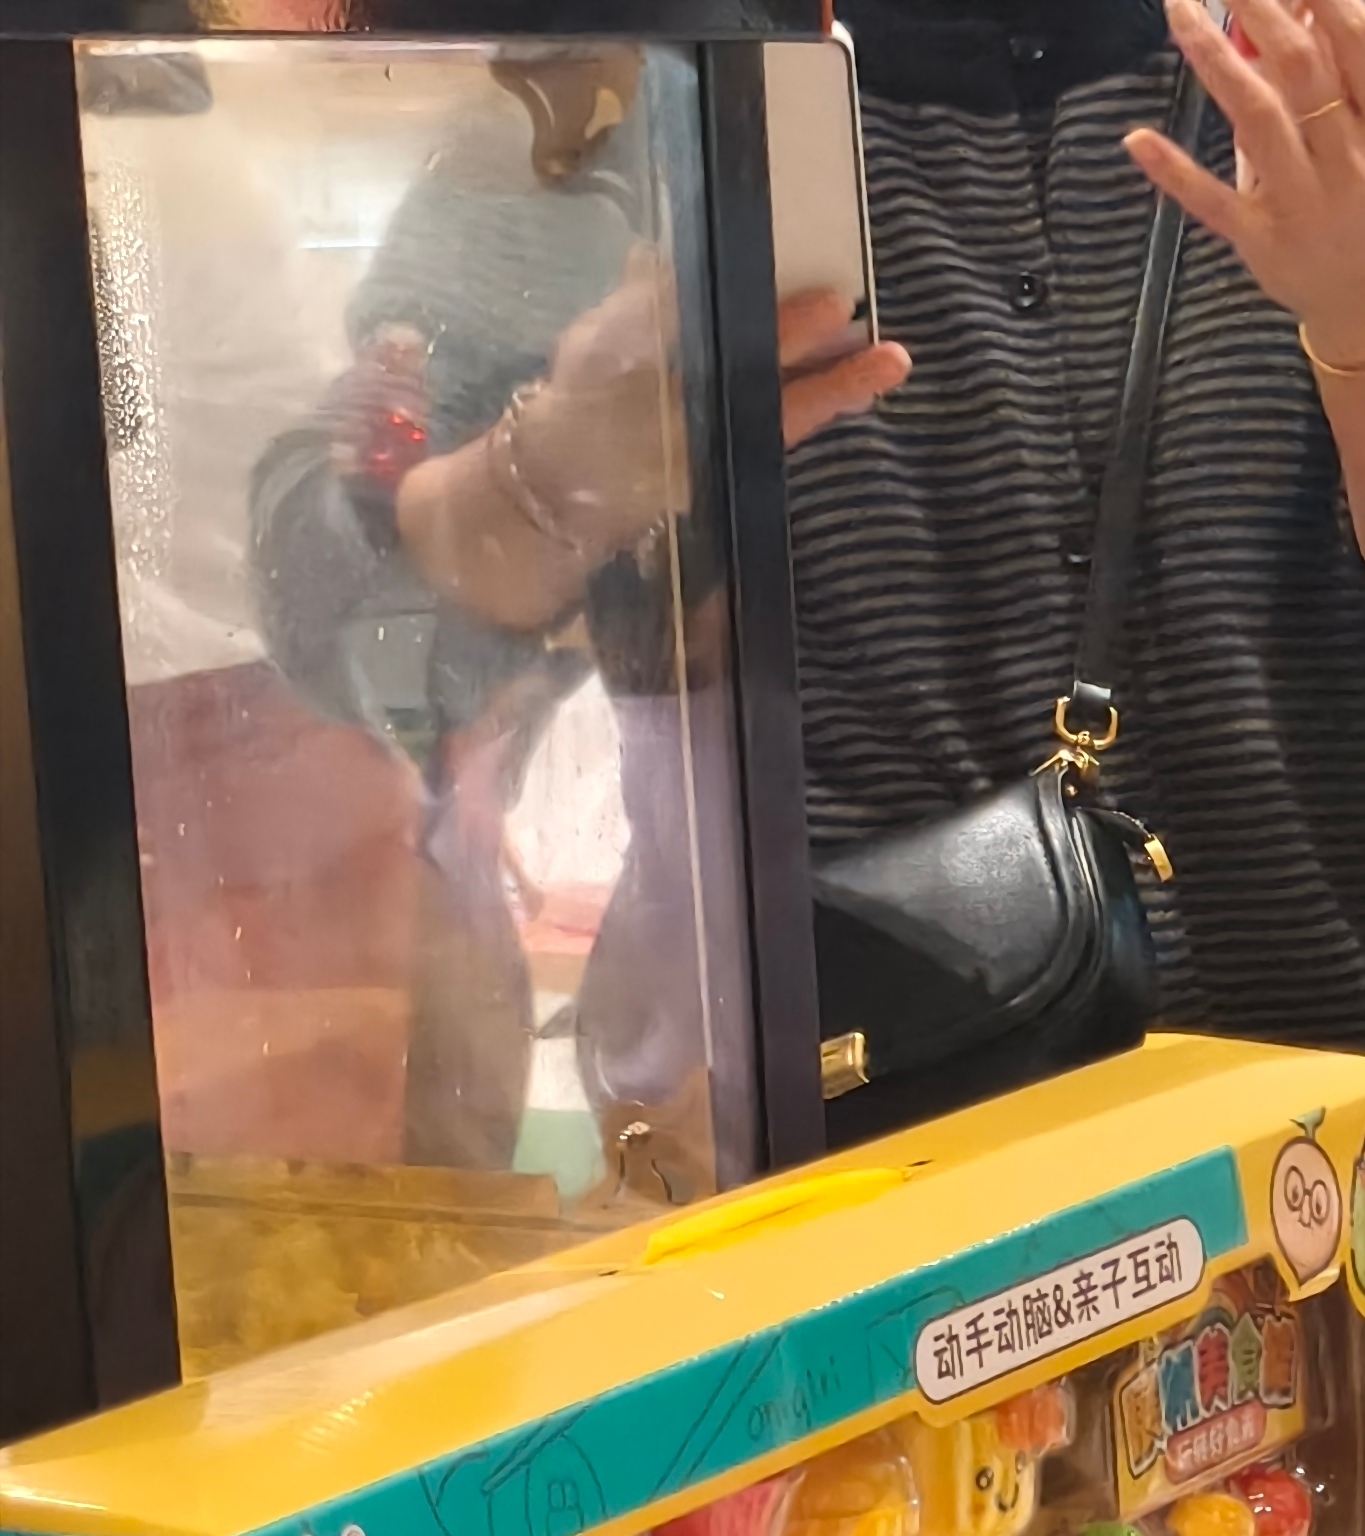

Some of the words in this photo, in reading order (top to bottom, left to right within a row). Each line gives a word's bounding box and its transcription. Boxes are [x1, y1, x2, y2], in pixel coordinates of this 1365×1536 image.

[933, 1232, 1183, 1381] 动手动脑&亲子互动
